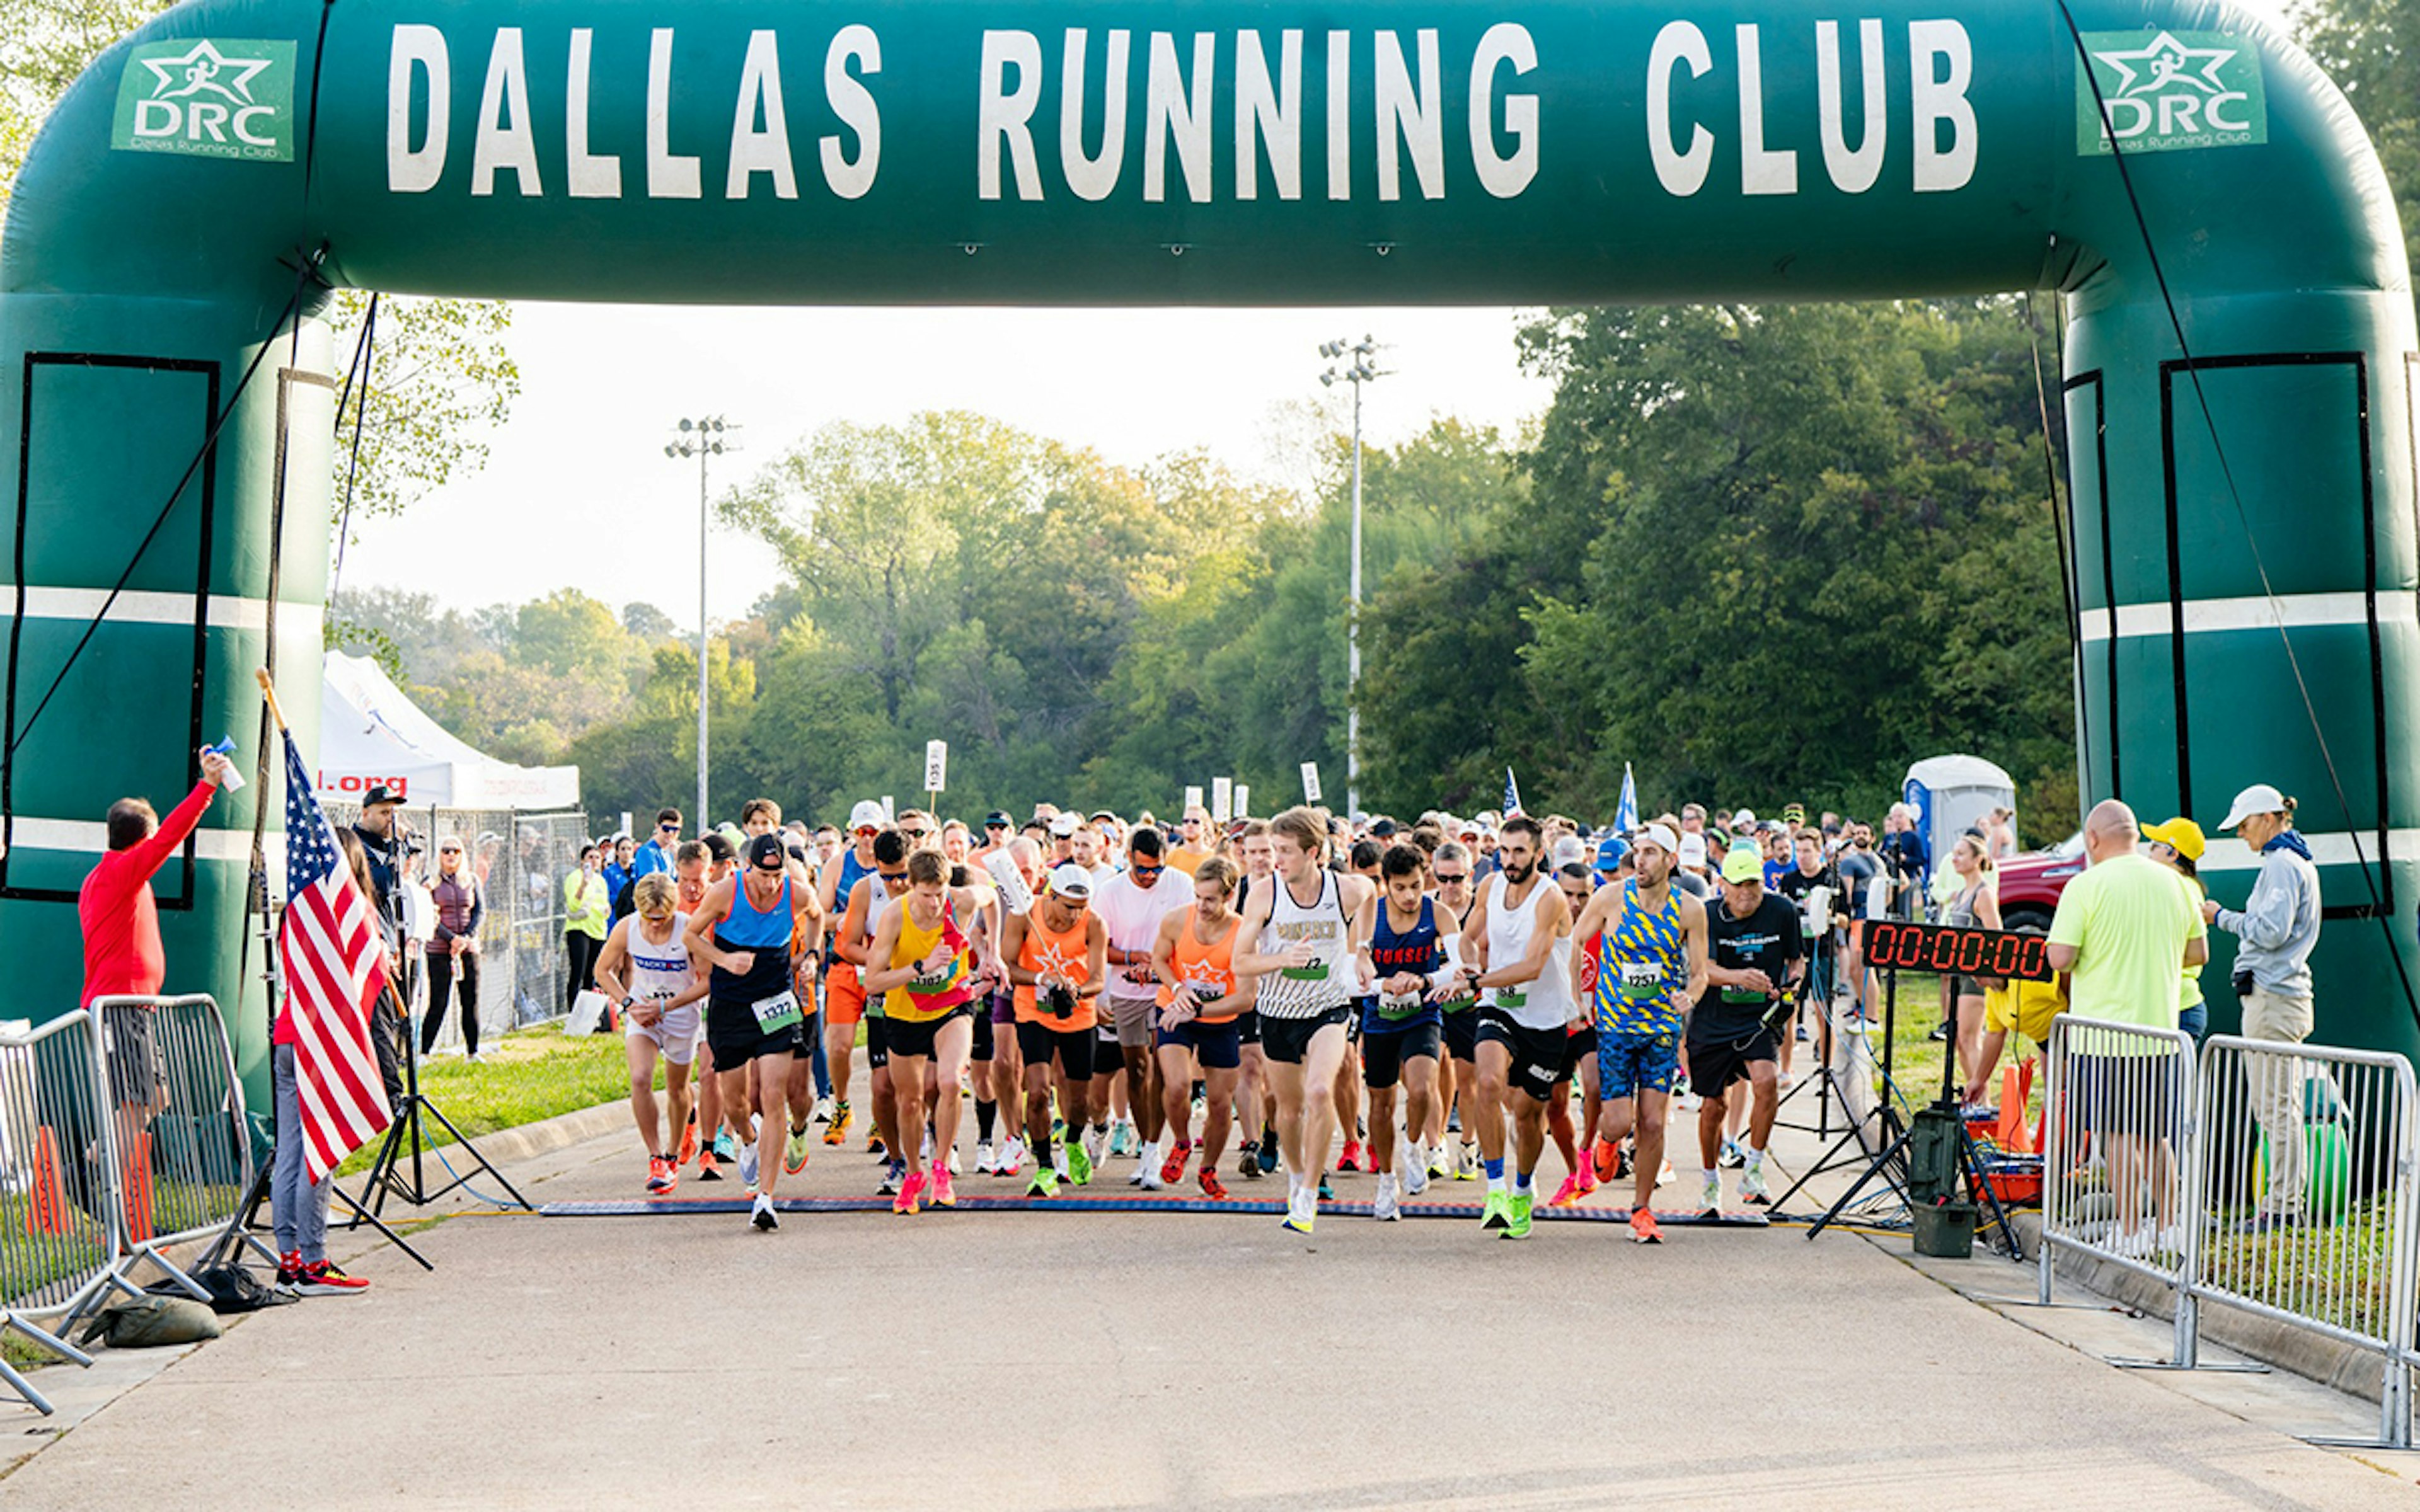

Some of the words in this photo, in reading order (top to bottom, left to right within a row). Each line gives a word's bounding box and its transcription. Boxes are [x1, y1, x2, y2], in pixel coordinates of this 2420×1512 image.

[134, 100, 277, 146] DRC
[388, 23, 882, 198] DALLAS
[977, 22, 1540, 202] RUNNING
[1646, 18, 1978, 196] CLUB
[2100, 91, 2250, 139] DRC
[177, 140, 239, 157] Running
[243, 146, 277, 158] Club
[2148, 134, 2211, 148] Running
[2216, 132, 2251, 143] Club
[1870, 924, 2047, 976] 00:00:00
[763, 1002, 792, 1021] 1322
